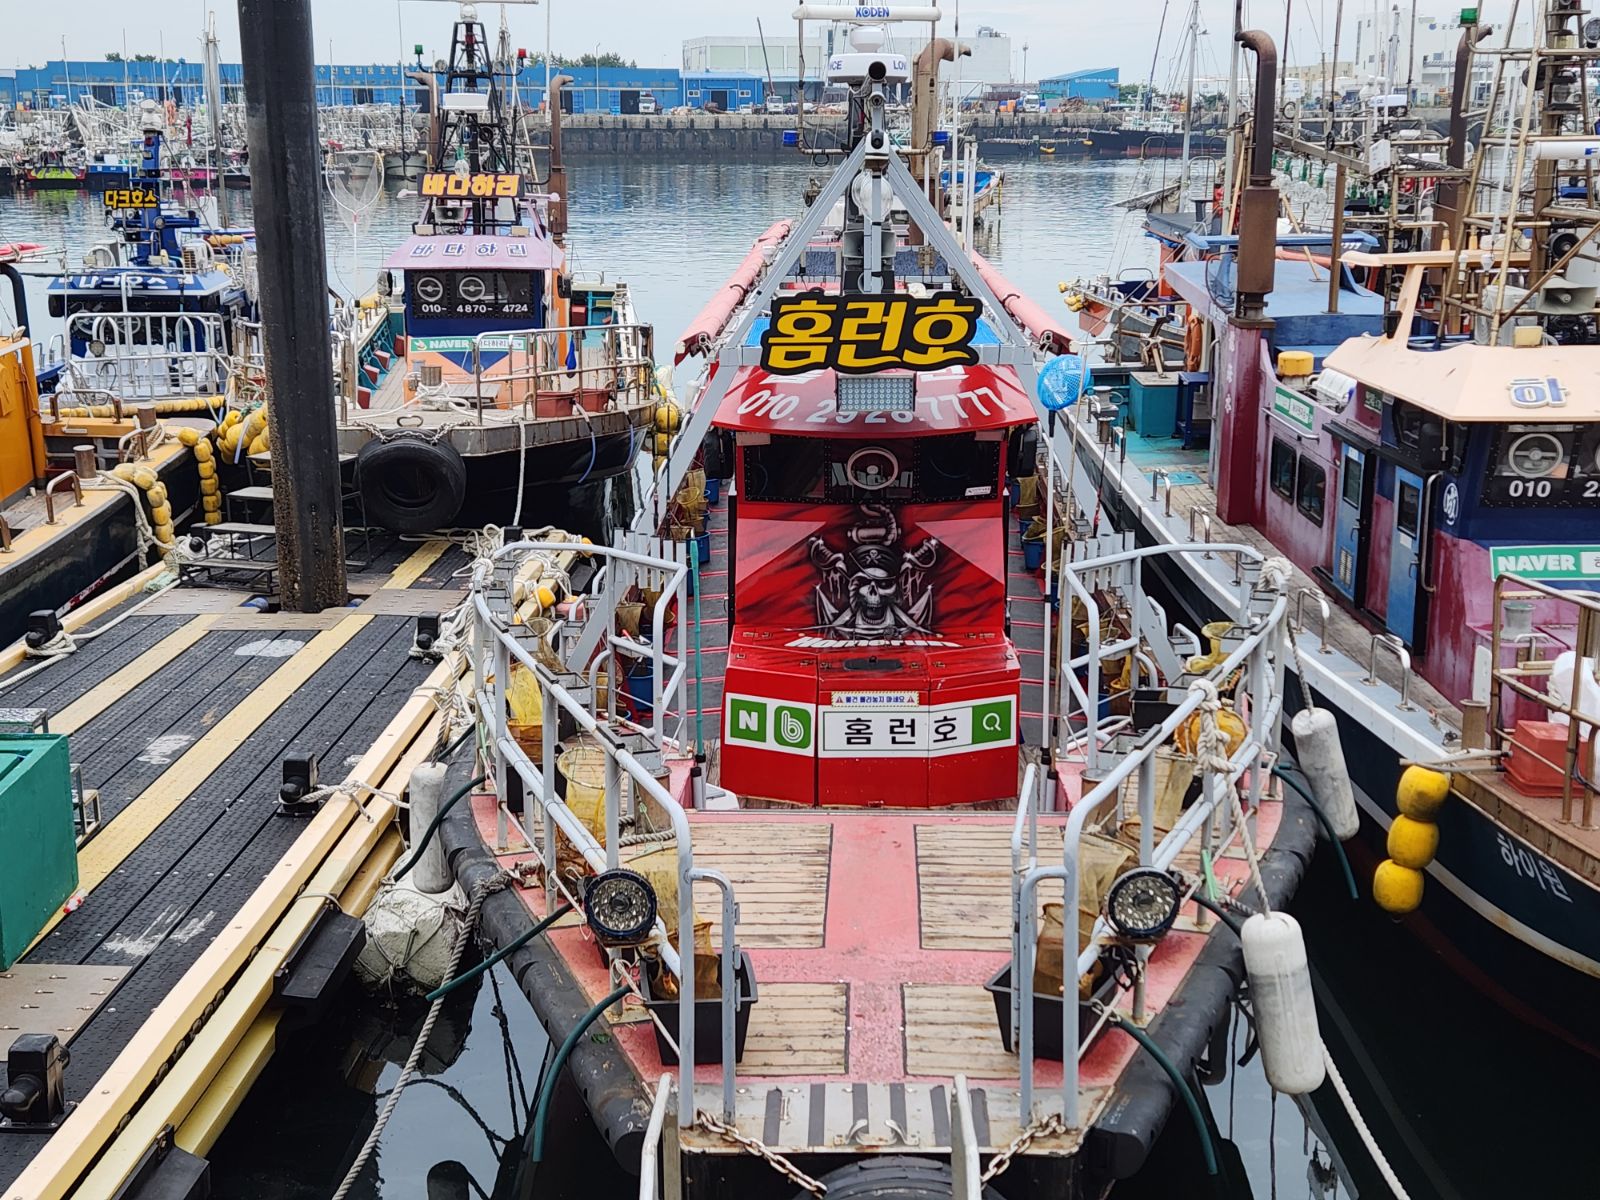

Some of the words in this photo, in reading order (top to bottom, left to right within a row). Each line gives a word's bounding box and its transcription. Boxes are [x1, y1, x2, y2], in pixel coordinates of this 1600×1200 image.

[855, 7, 890, 17] KODEN
[421, 173, 520, 196] 바다하리
[104, 190, 158, 209] 다크호스
[502, 304, 529, 313] 4724
[766, 299, 977, 369] 홈런호
[429, 339, 470, 349] NAVER
[1509, 480, 1552, 498] 010
[1582, 481, 1600, 498] 2
[1496, 554, 1577, 571] NAVER
[1497, 832, 1573, 903] 하이원
